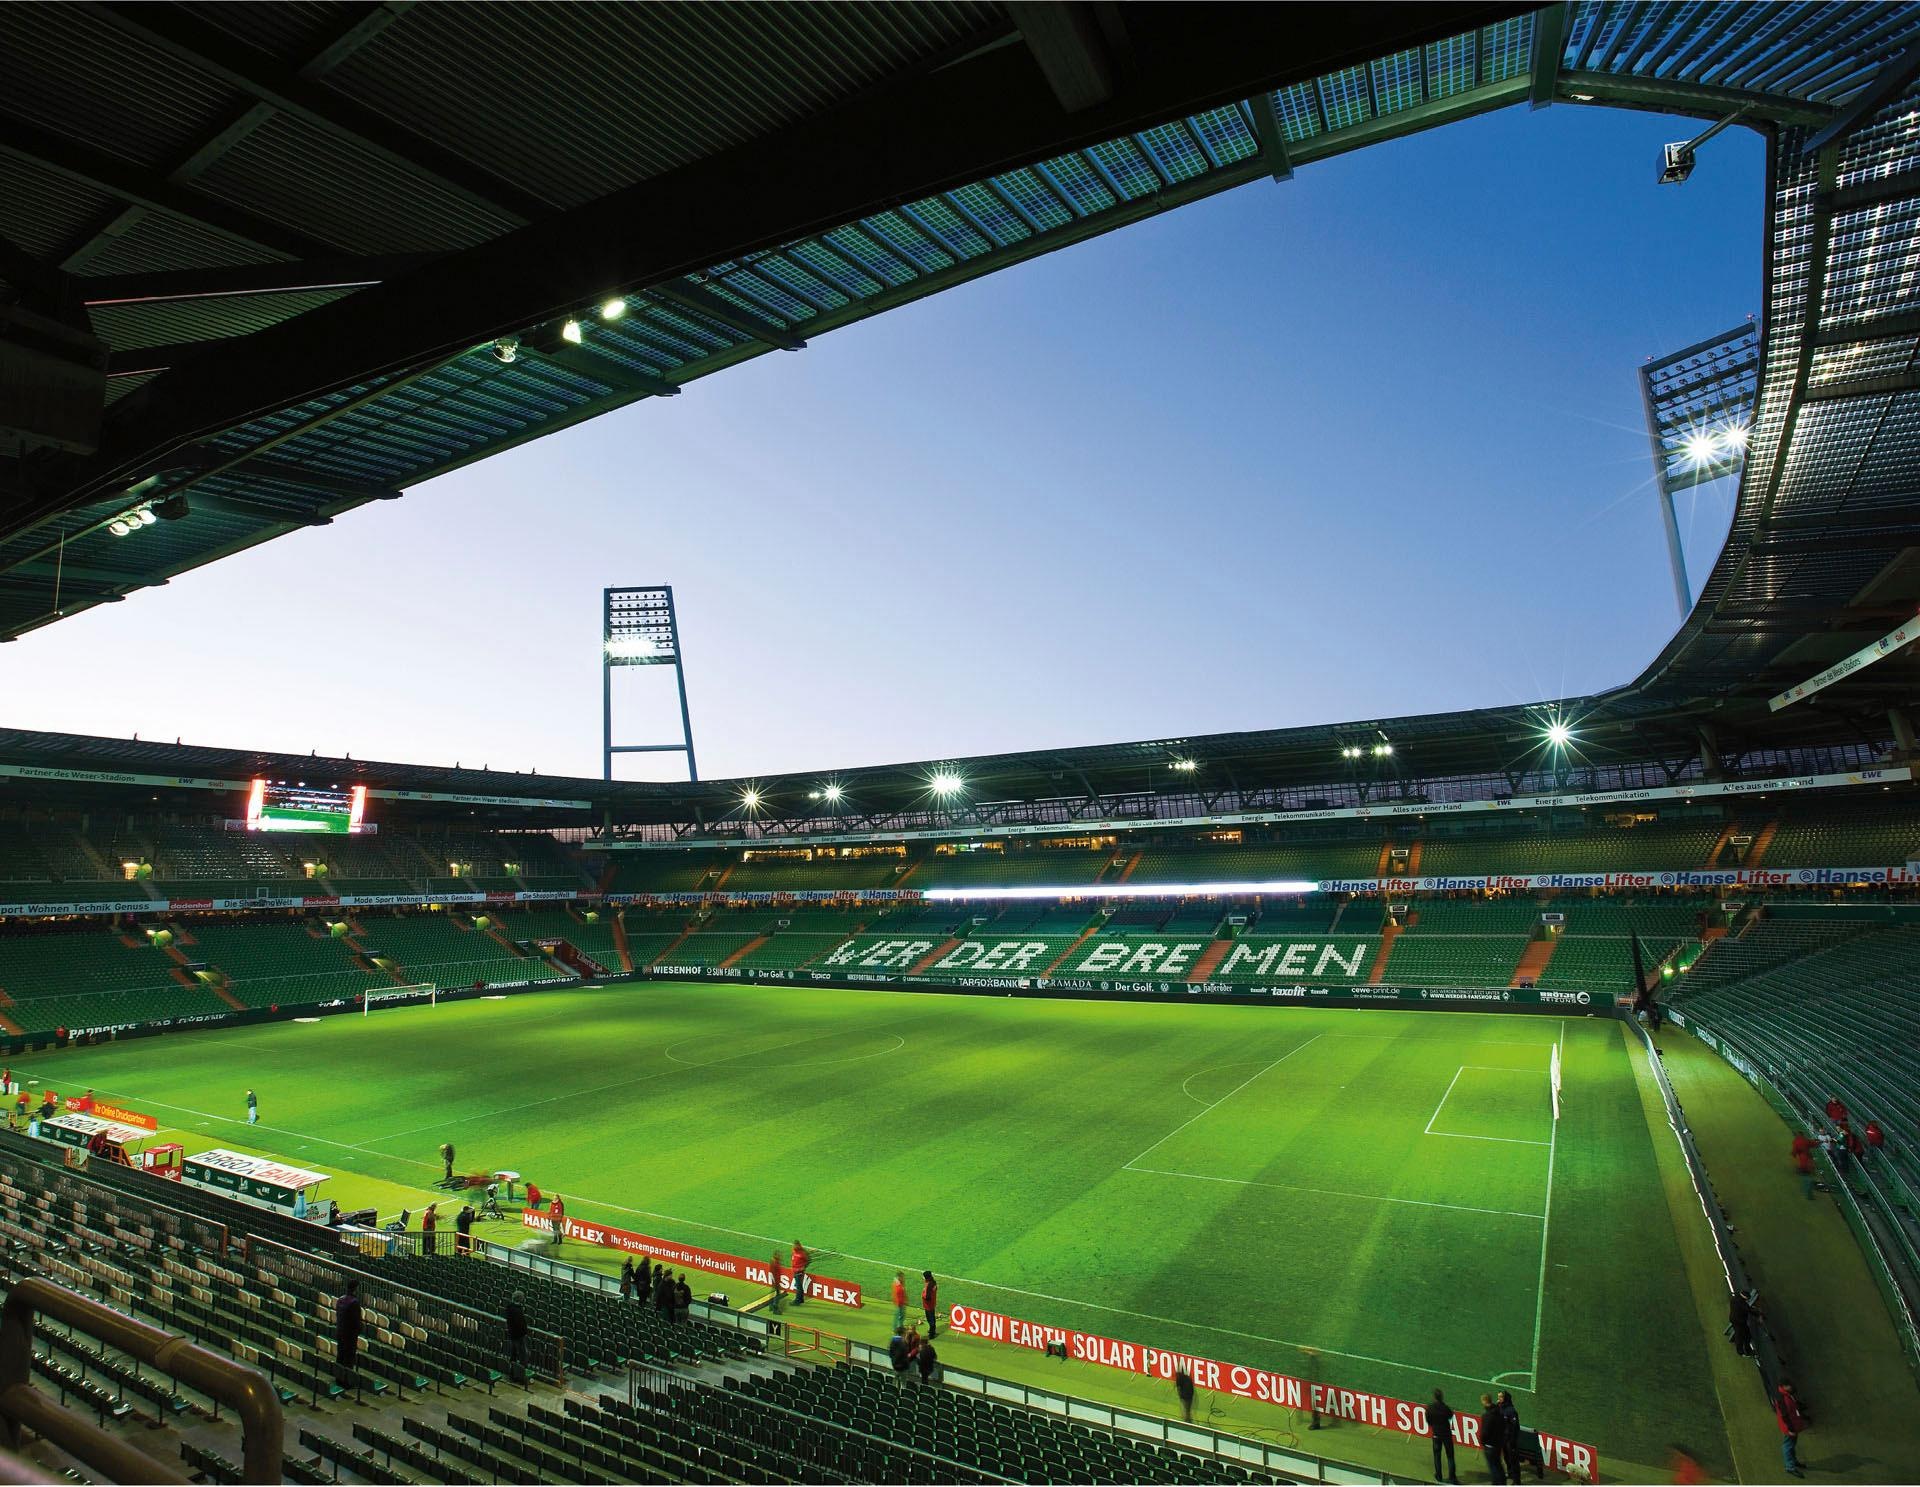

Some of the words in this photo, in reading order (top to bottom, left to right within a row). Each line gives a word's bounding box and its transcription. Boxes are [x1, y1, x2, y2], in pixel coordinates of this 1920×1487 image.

[19, 767, 53, 777] Partner
[54, 770, 69, 778] des
[71, 772, 136, 782] Weser-Stadions
[1862, 770, 1883, 779] EWE
[1763, 780, 1786, 789] einr
[1789, 777, 1814, 786] and
[1535, 798, 1563, 806] Energie
[1575, 791, 1650, 803] Telekommunikation
[1443, 803, 1462, 811] Hand
[1274, 811, 1336, 820] Telekommunikation
[1551, 873, 1655, 887] HanseLifter
[1676, 870, 1792, 884] HanseLifter
[1816, 867, 1920, 883] HanseLi
[1331, 878, 1419, 891] HanseLifter
[1436, 876, 1532, 889] HanseLifter
[375, 896, 395, 904] Sport
[672, 892, 730, 902] HanseLifter
[741, 890, 797, 901] HanseLifter
[806, 890, 859, 900] HanseLifter
[869, 889, 924, 899] HanseLifter
[0, 904, 23, 915] port
[28, 903, 70, 913] Wohnen
[72, 902, 111, 912] Technik
[114, 902, 150, 911] Genuss
[170, 902, 212, 910] dodenhof
[224, 900, 235, 908] Die
[824, 940, 933, 967] WER
[935, 941, 1049, 970] DER
[1076, 943, 1201, 974] BRE
[1220, 943, 1367, 977] MEN
[653, 966, 702, 975] WIESENHOF
[712, 967, 723, 976] SUN
[724, 967, 741, 977] EARTH
[758, 970, 770, 978] Der
[811, 971, 831, 980] tipico
[847, 974, 886, 982] NIKEFOOTBALL.COM
[1051, 979, 1092, 988] RAMADA
[1115, 982, 1130, 991] Der
[1132, 982, 1155, 992] Golf.
[1270, 985, 1307, 997] taxofit
[101, 1104, 115, 1117] Online
[115, 1107, 147, 1125] Druckpartner
[572, 1225, 604, 1244] FLEX
[611, 1234, 622, 1245] Ihr
[623, 1237, 679, 1260] Systempartner
[681, 1250, 694, 1263] für
[695, 1254, 737, 1273] Hydraulik
[812, 1282, 858, 1306] FLEX
[771, 1323, 779, 1335] Y
[969, 1311, 1004, 1340] SUN
[1010, 1320, 1066, 1349] EARTH
[1073, 1334, 1136, 1371] SOLAR
[1143, 1349, 1221, 1390] POWER
[1256, 1372, 1302, 1408] SUN
[1310, 1384, 1388, 1426] EARTH
[1396, 1402, 1481, 1447] SOAR
